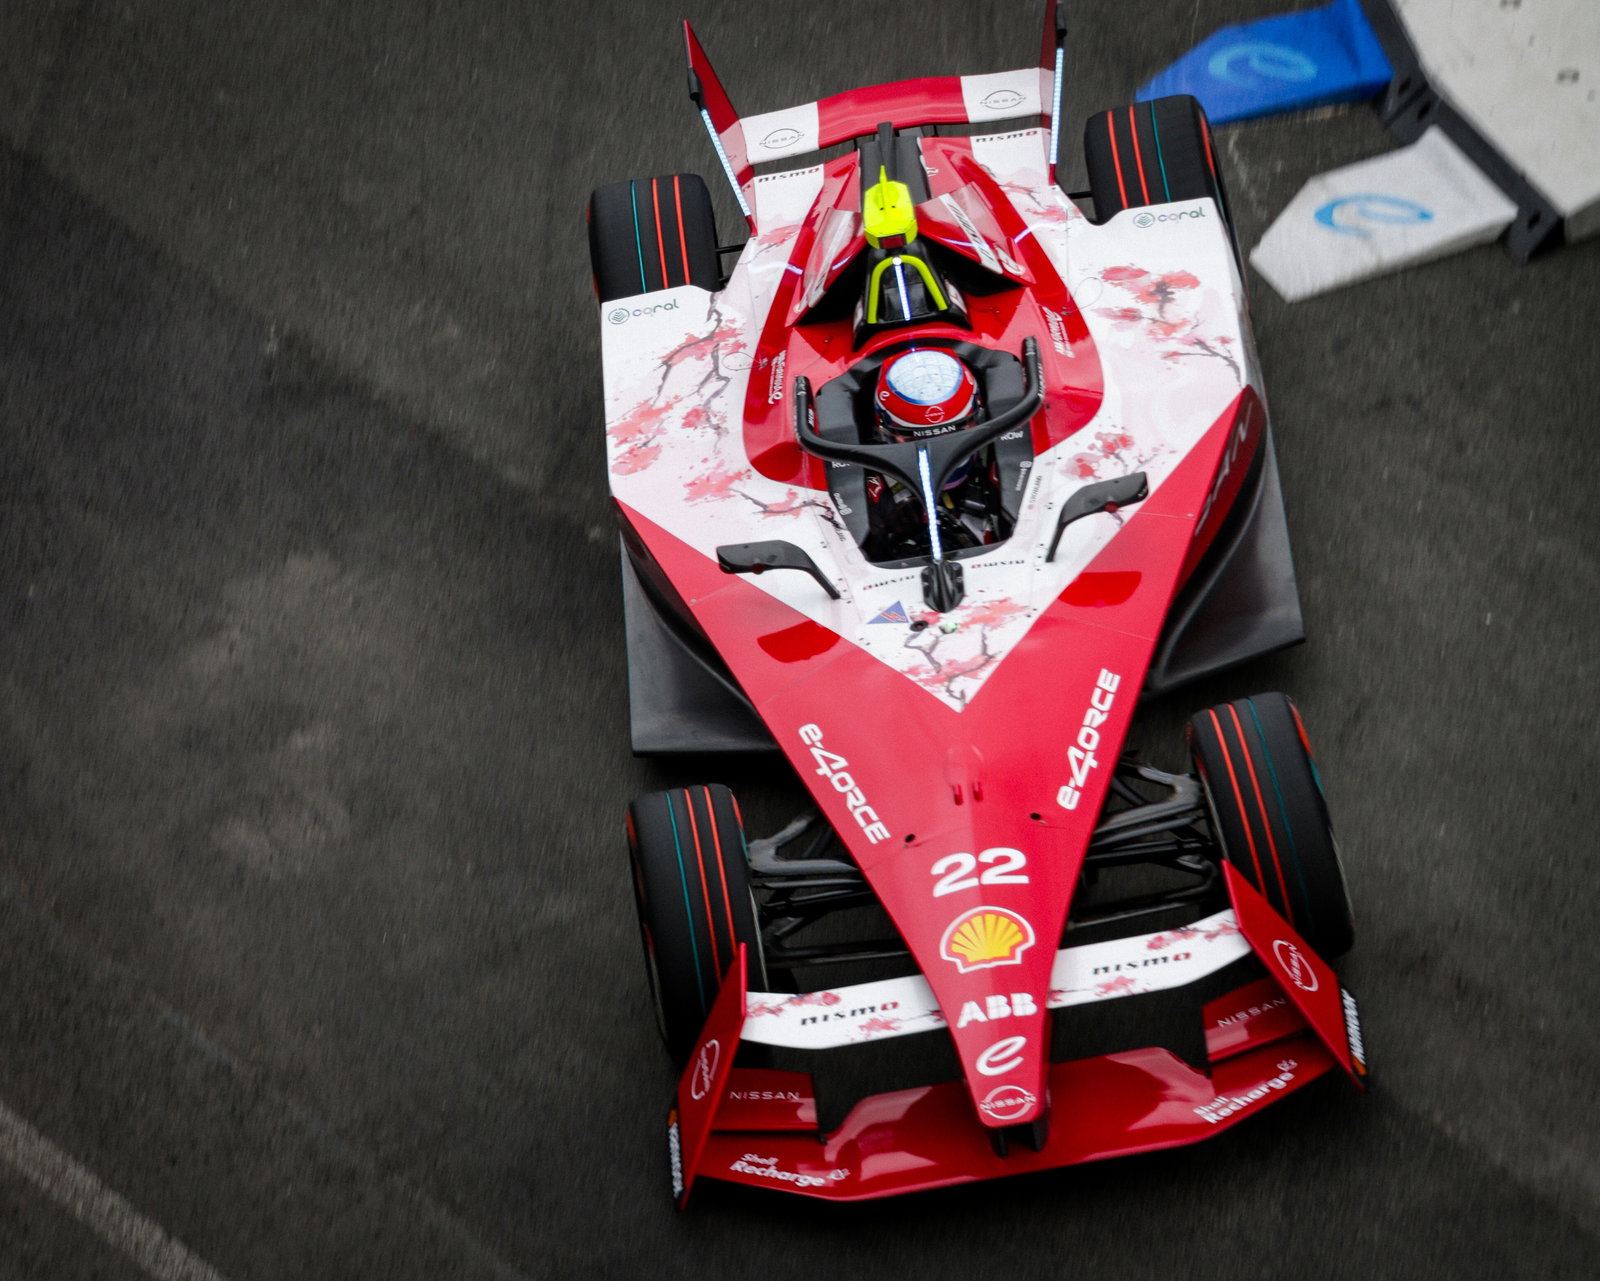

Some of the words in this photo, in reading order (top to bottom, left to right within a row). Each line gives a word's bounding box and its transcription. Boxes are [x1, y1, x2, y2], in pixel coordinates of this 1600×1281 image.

[913, 425, 956, 437] NISSAN
[931, 847, 1030, 898] 22
[1092, 952, 1191, 975] nismo
[801, 1002, 899, 1026] nismo
[957, 992, 1038, 1029] ABB
[1217, 999, 1286, 1028] NISSAN
[729, 1091, 801, 1100] NISSAN
[979, 1094, 1037, 1112] NISSAN
[1198, 1072, 1295, 1124] Recharge
[741, 1153, 779, 1165] Shell
[730, 1160, 825, 1187] Recharge
